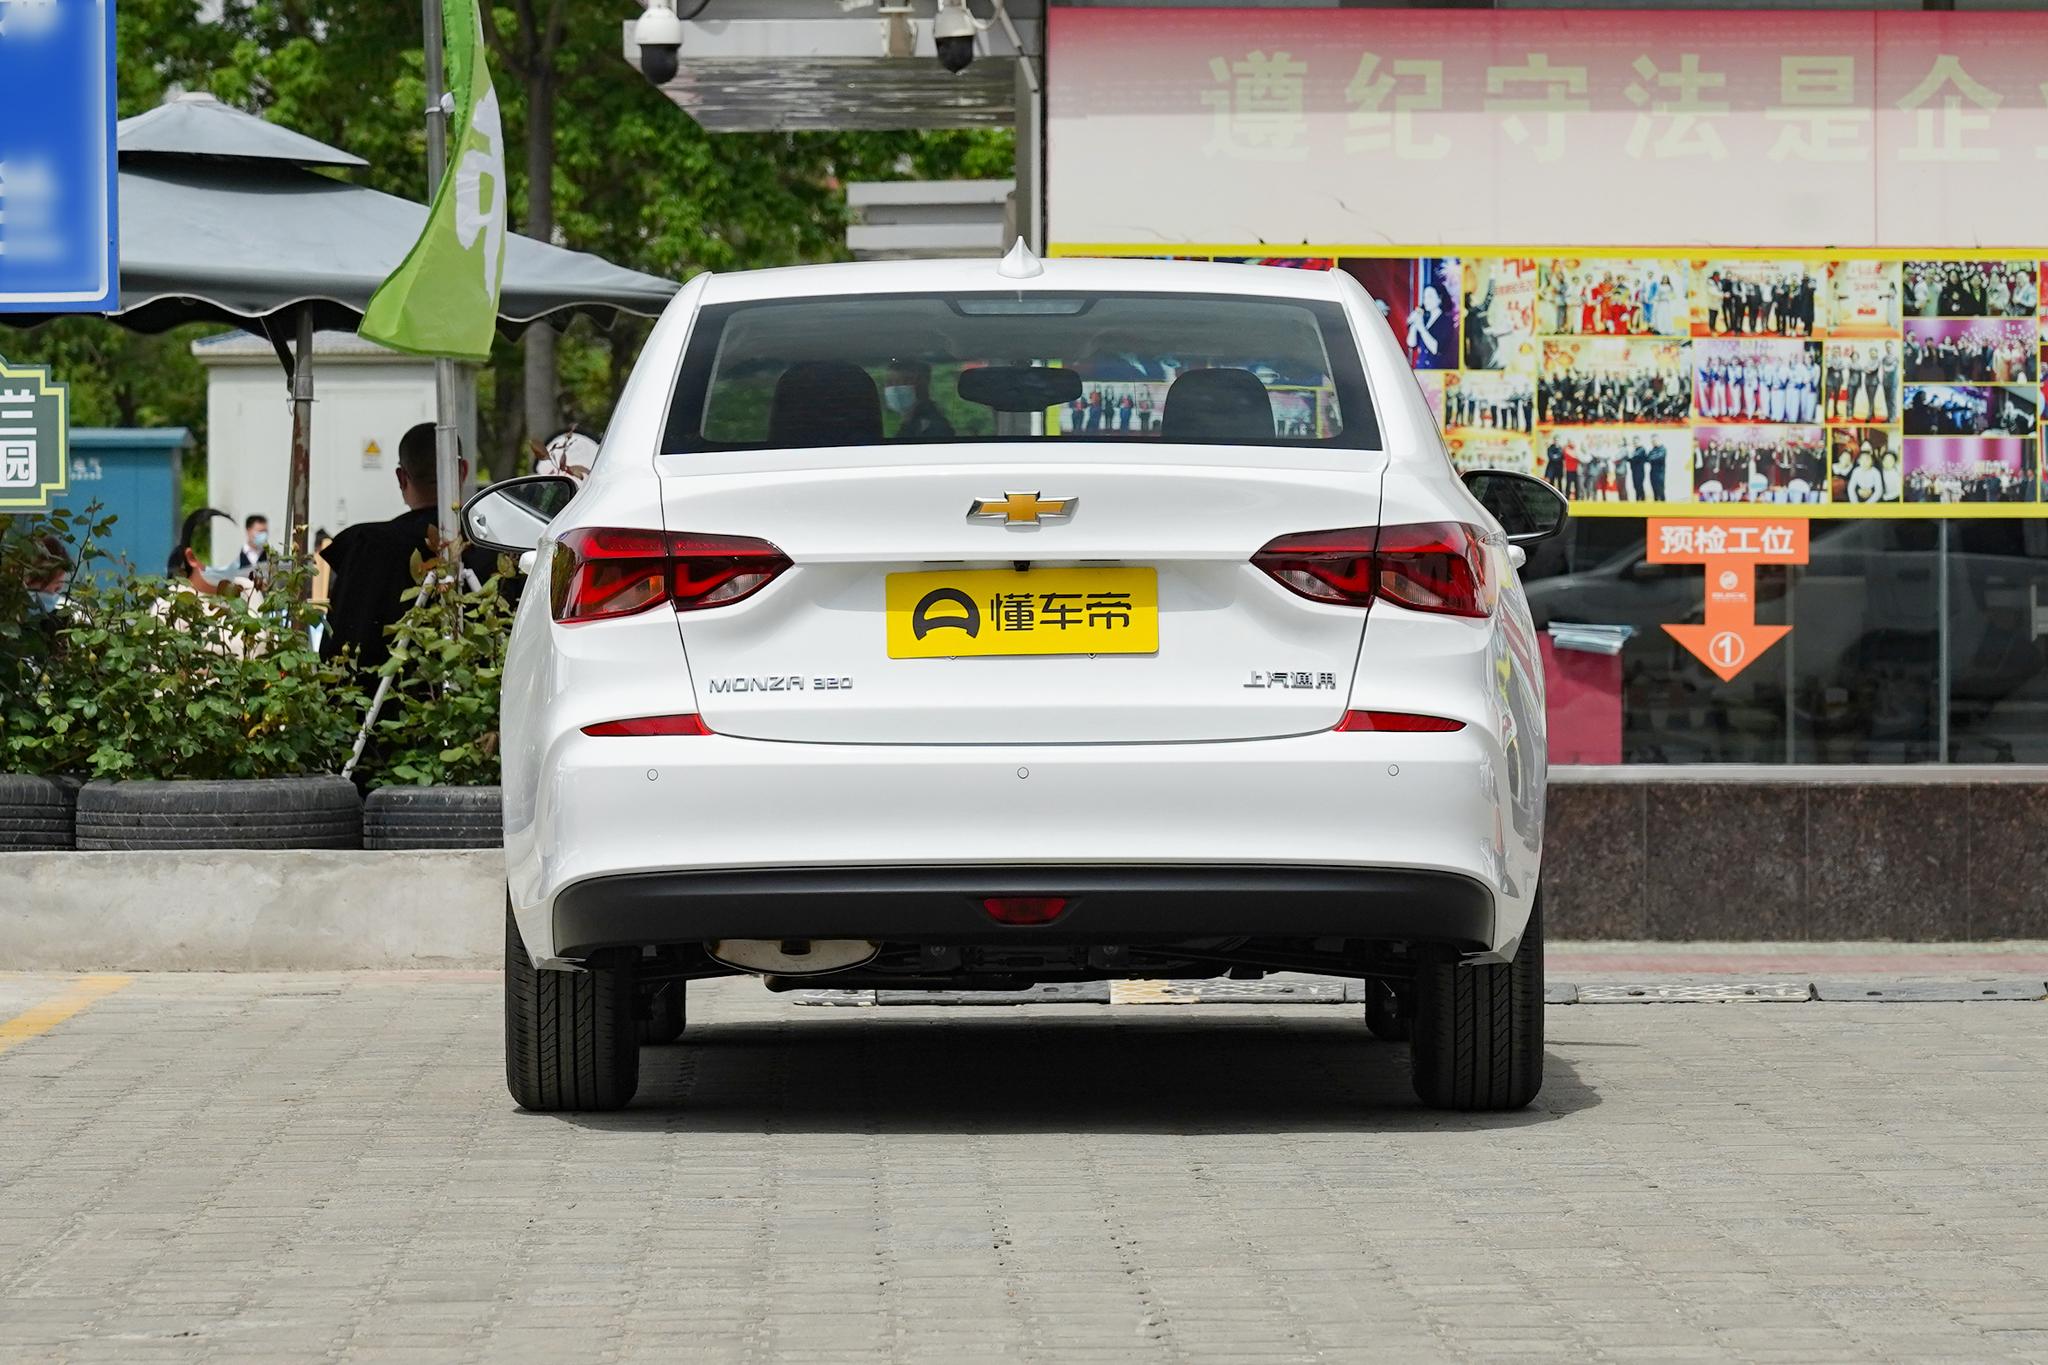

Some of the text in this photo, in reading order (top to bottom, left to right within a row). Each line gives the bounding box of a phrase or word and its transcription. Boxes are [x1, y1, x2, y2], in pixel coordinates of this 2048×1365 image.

[1200, 50, 2048, 162] 遵纪守法是企
[1660, 525, 1795, 555] 预检工位
[990, 592, 1132, 631] 懂车帝
[709, 676, 854, 694] MONZA 320
[1243, 671, 1337, 689] 上汽通用
